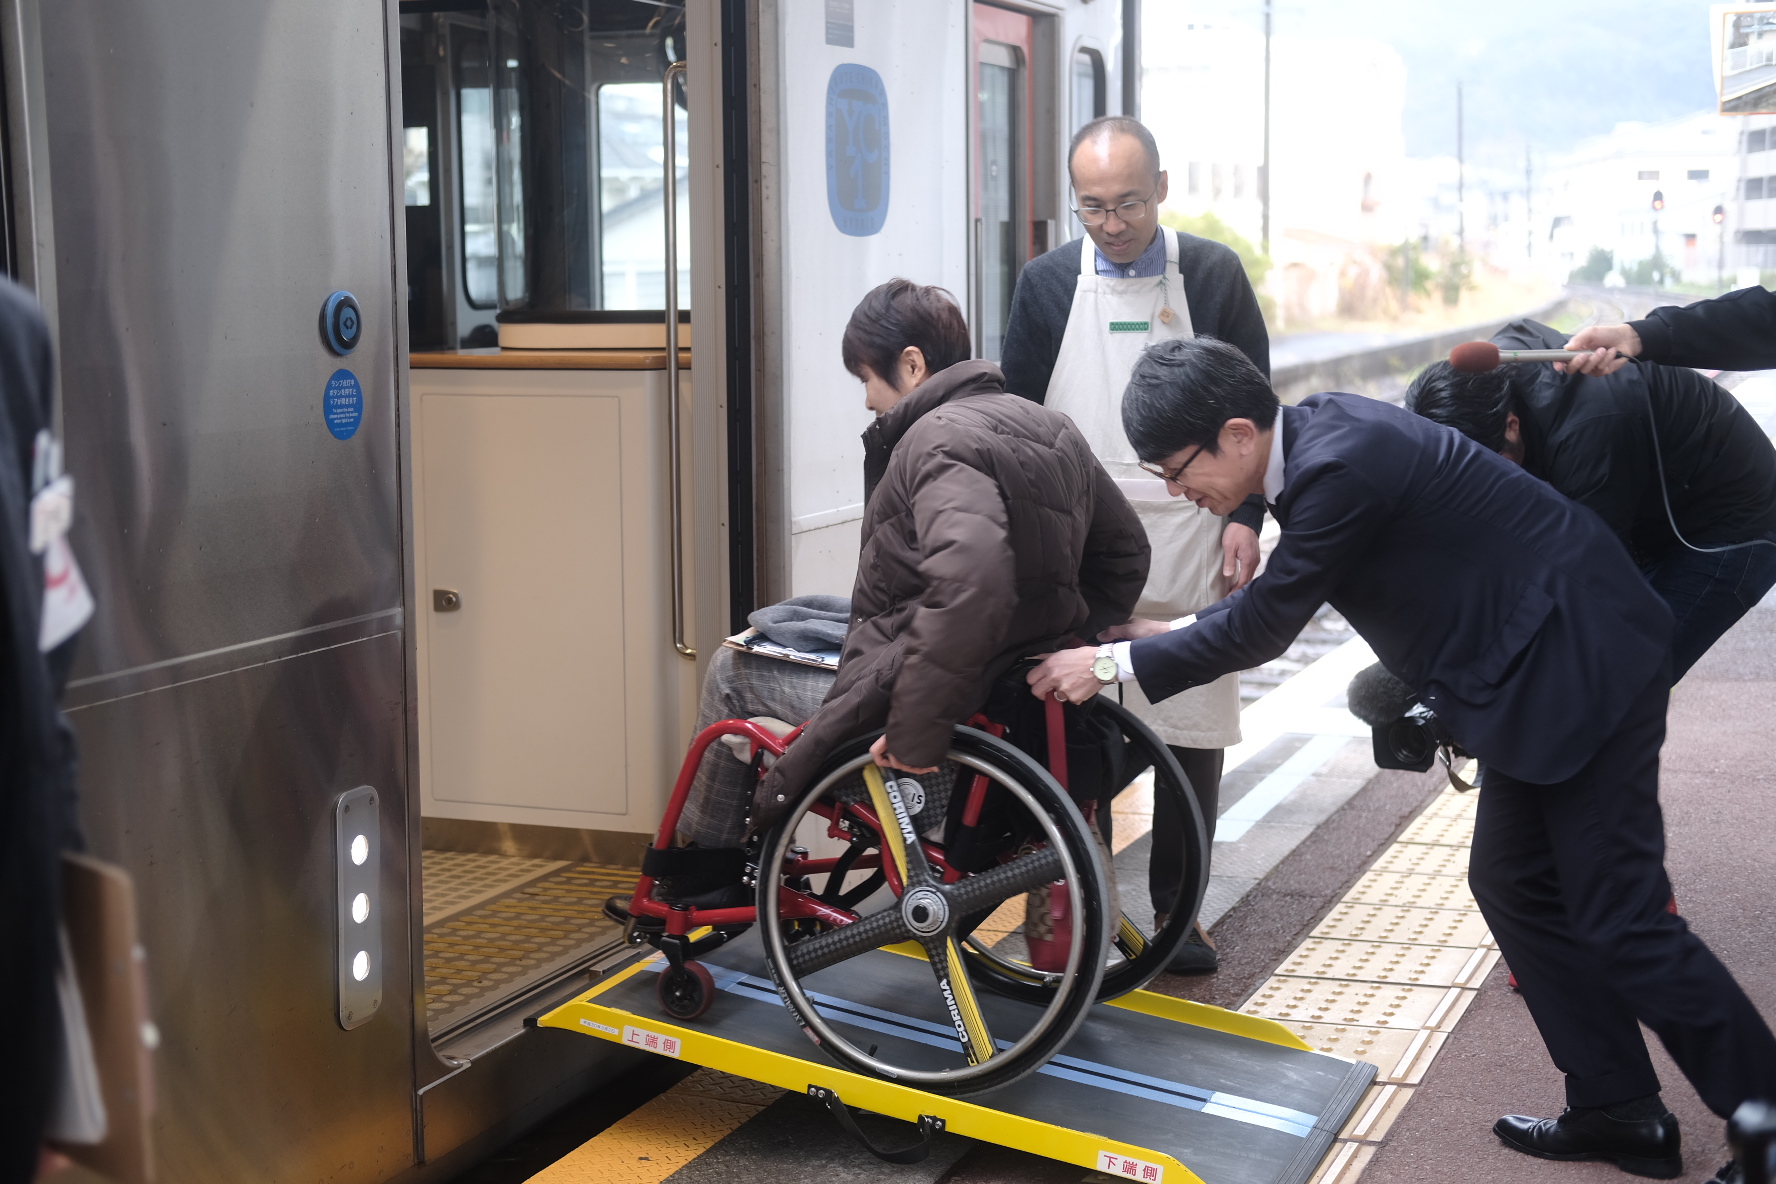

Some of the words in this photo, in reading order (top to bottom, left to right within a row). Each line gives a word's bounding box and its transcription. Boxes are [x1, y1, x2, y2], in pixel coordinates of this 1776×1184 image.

[330, 388, 356, 396] ボタンを押すと
[330, 398, 356, 406] ドアが開きます
[884, 780, 916, 845] CORIMA
[939, 978, 969, 1043] CORIMA
[627, 1029, 677, 1054] 上端側
[1103, 1154, 1158, 1182] 下端側
